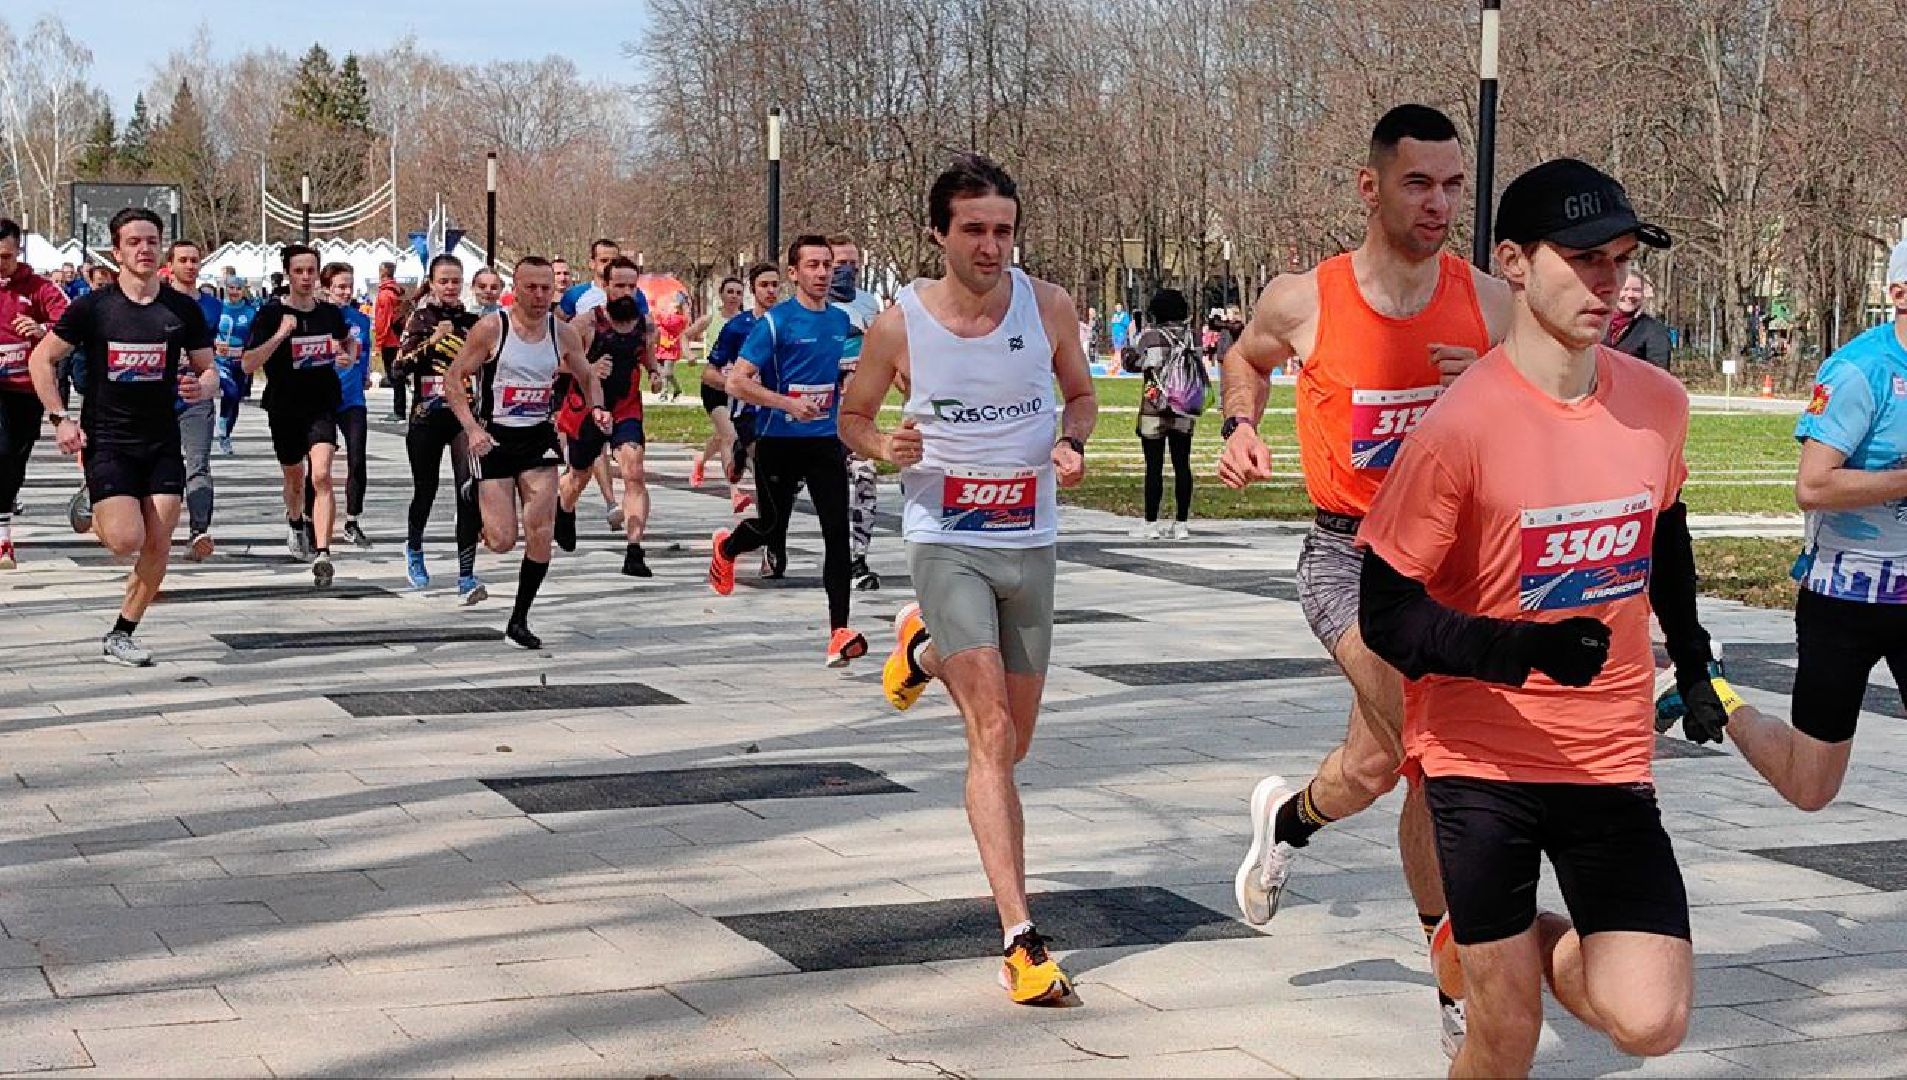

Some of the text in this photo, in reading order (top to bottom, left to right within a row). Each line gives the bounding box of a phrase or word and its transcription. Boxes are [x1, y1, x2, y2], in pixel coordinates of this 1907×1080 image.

[113, 353, 161, 367] 3070
[1372, 405, 1428, 435] 313
[956, 483, 1027, 505] 3015
[1536, 520, 1641, 567] 3309
